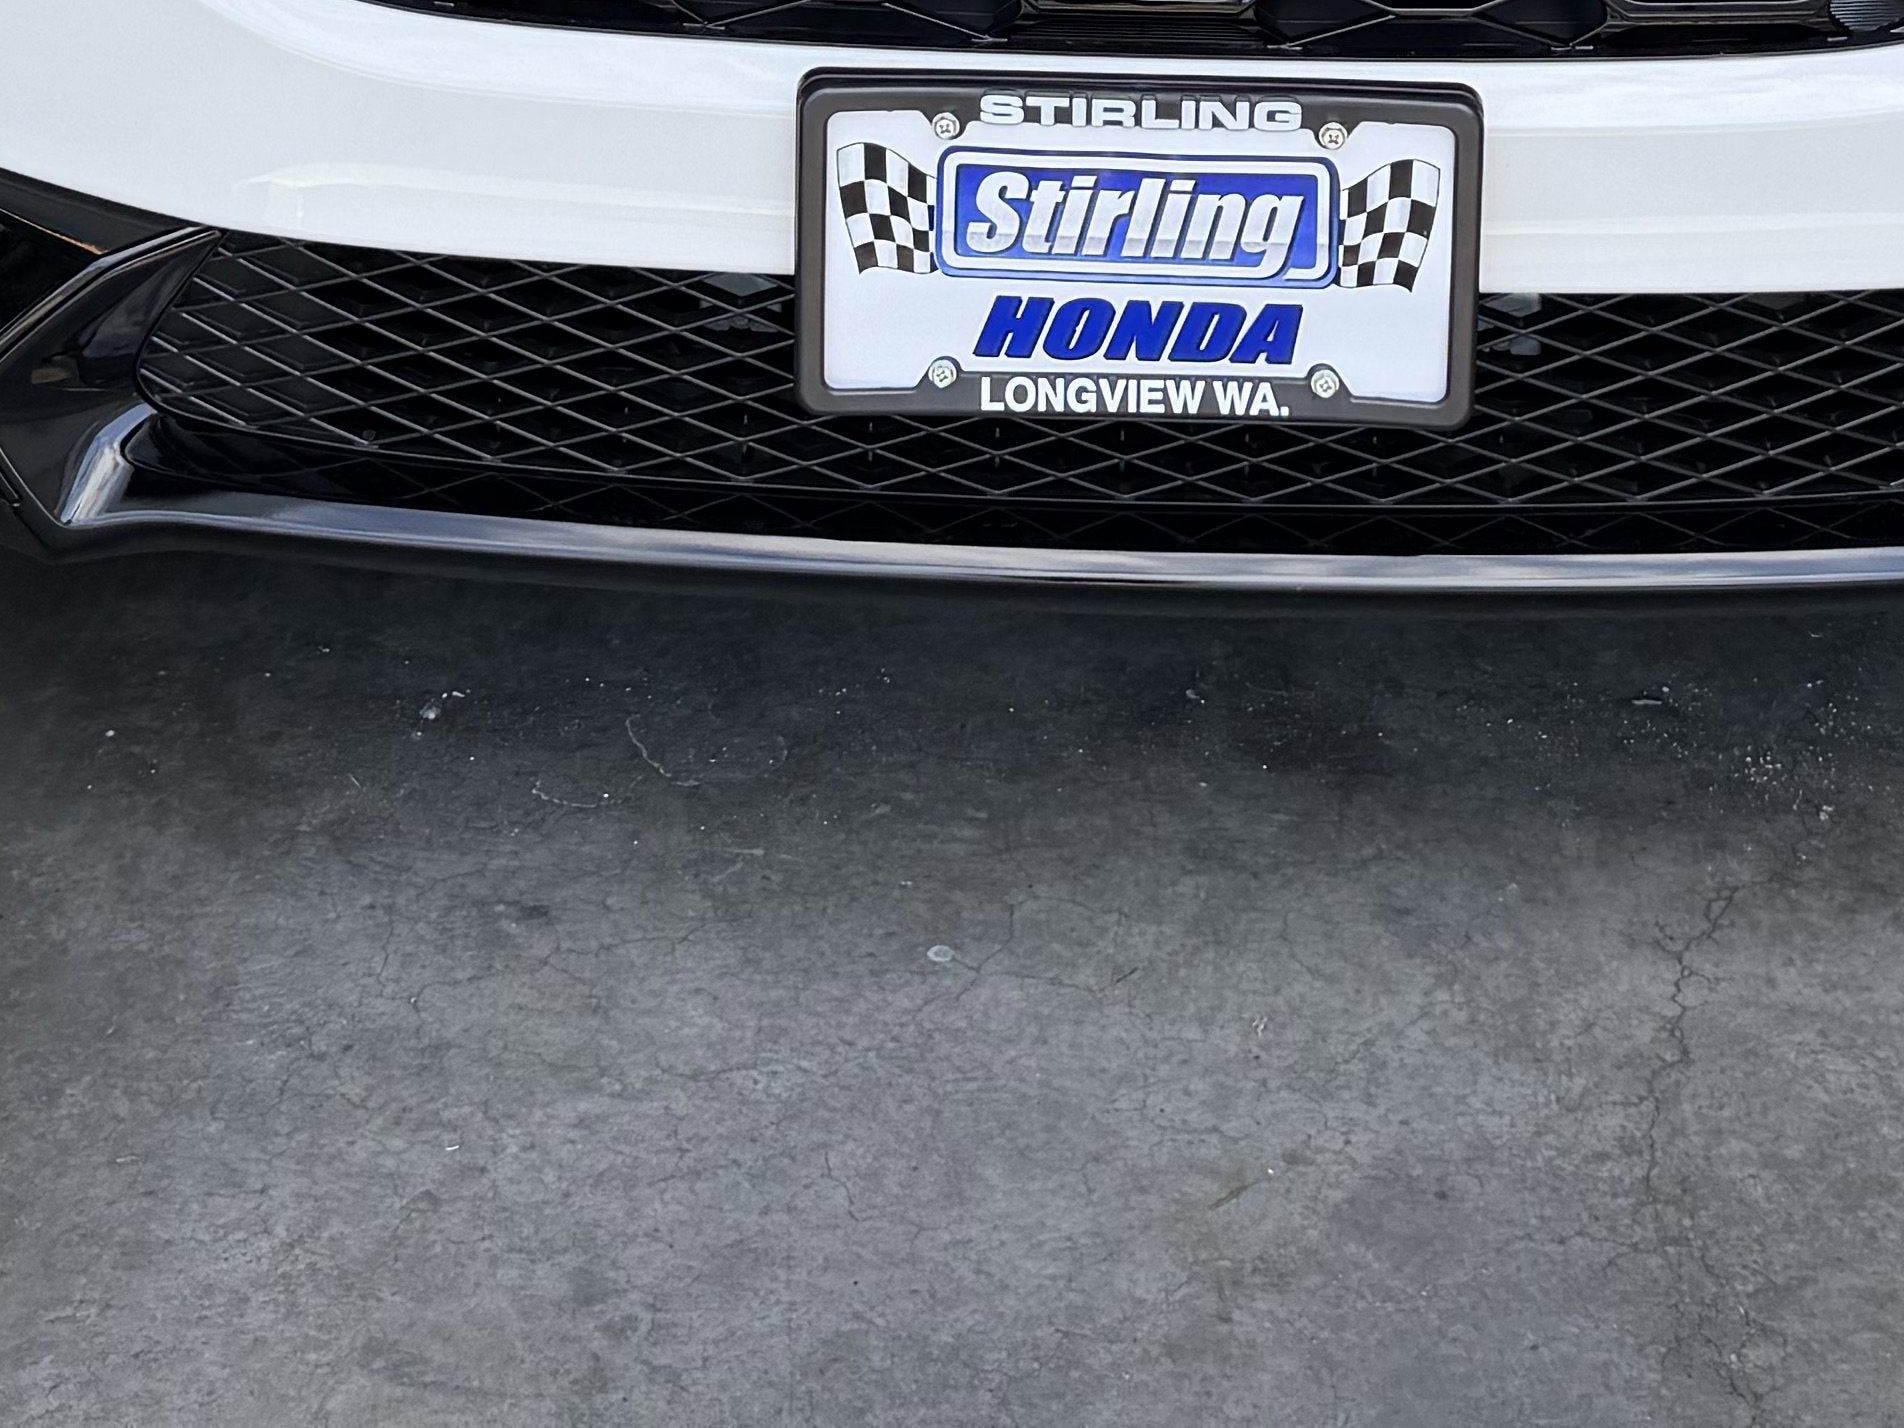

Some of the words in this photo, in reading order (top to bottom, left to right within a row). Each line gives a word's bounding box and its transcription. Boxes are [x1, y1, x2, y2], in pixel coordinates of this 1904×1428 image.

[979, 94, 1302, 132] STIRLING
[966, 170, 1304, 280] Stirling
[972, 294, 1303, 364] HONDA
[980, 376, 1206, 414] LONGVIEW
[1213, 380, 1290, 417] WA.
